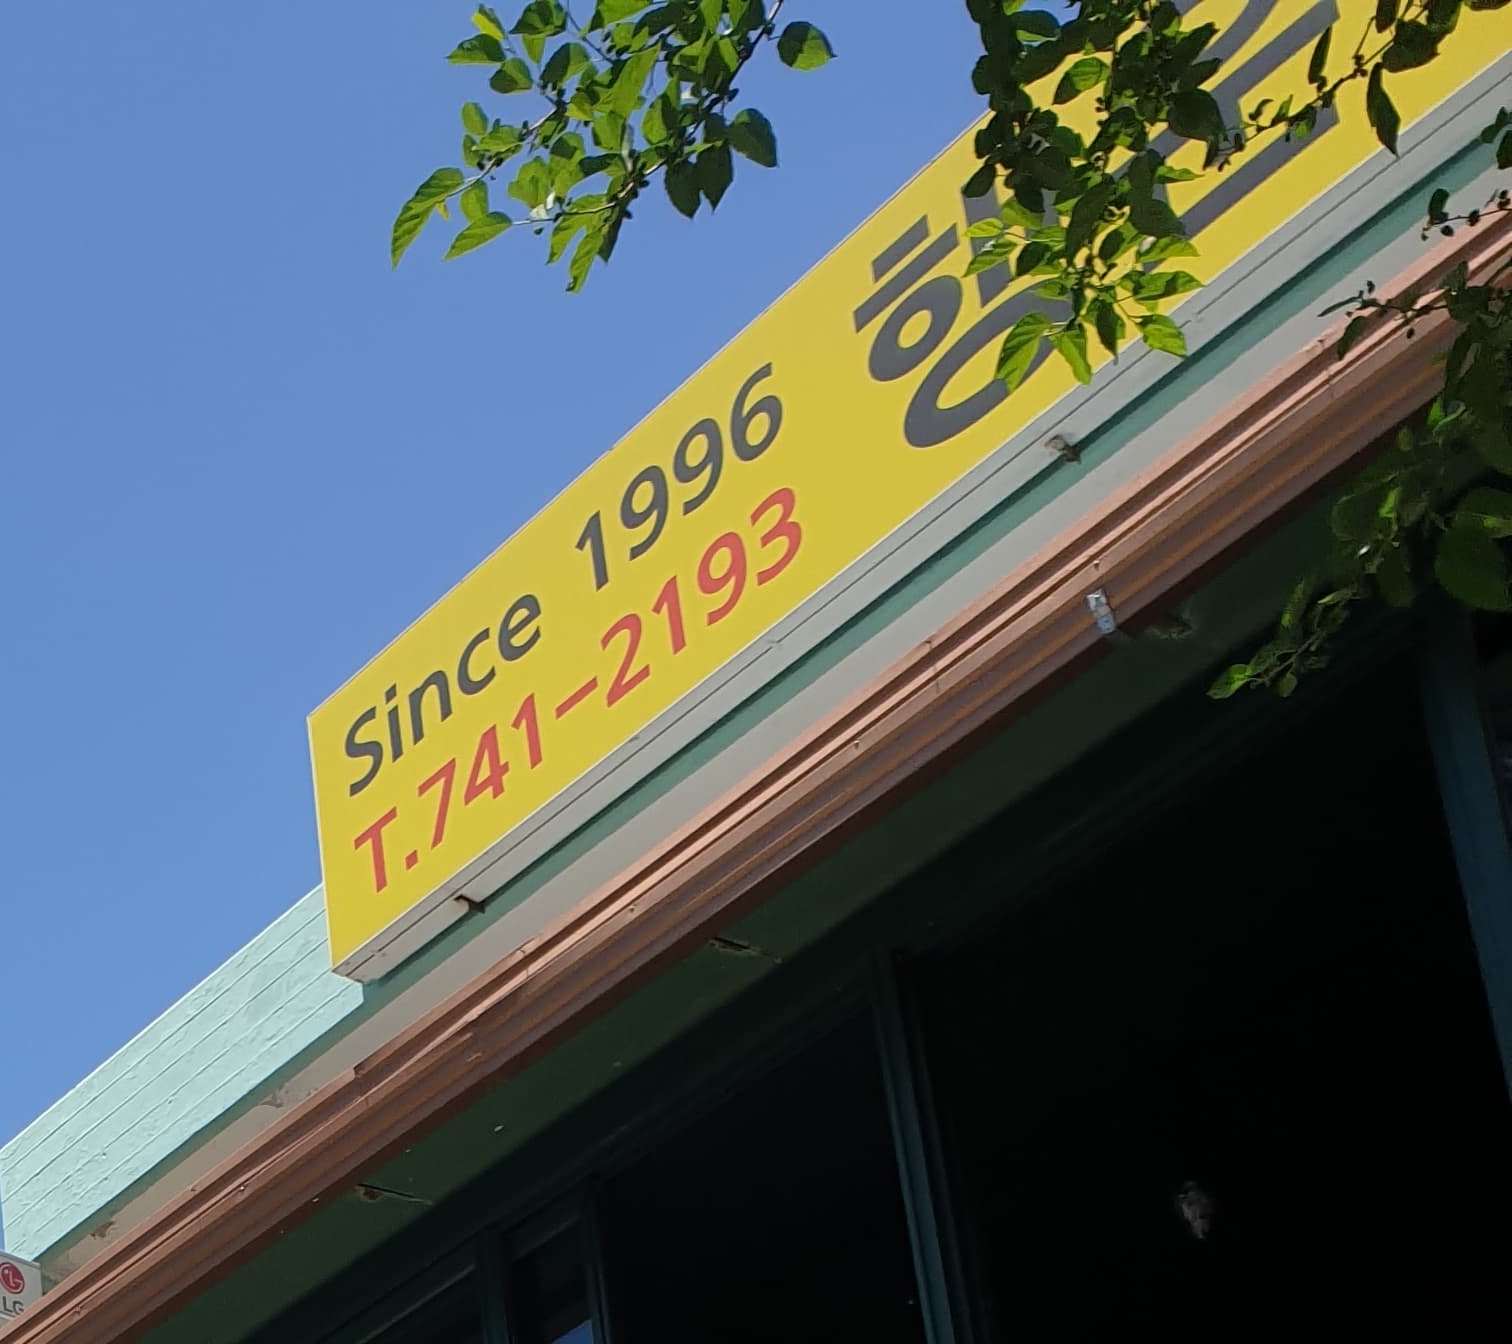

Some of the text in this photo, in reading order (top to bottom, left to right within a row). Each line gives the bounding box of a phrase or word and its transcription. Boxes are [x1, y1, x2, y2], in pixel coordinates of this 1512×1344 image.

[344, 362, 784, 797] Since 1996
[353, 487, 803, 893] T.741-2193
[2, 1295, 25, 1316] LG
